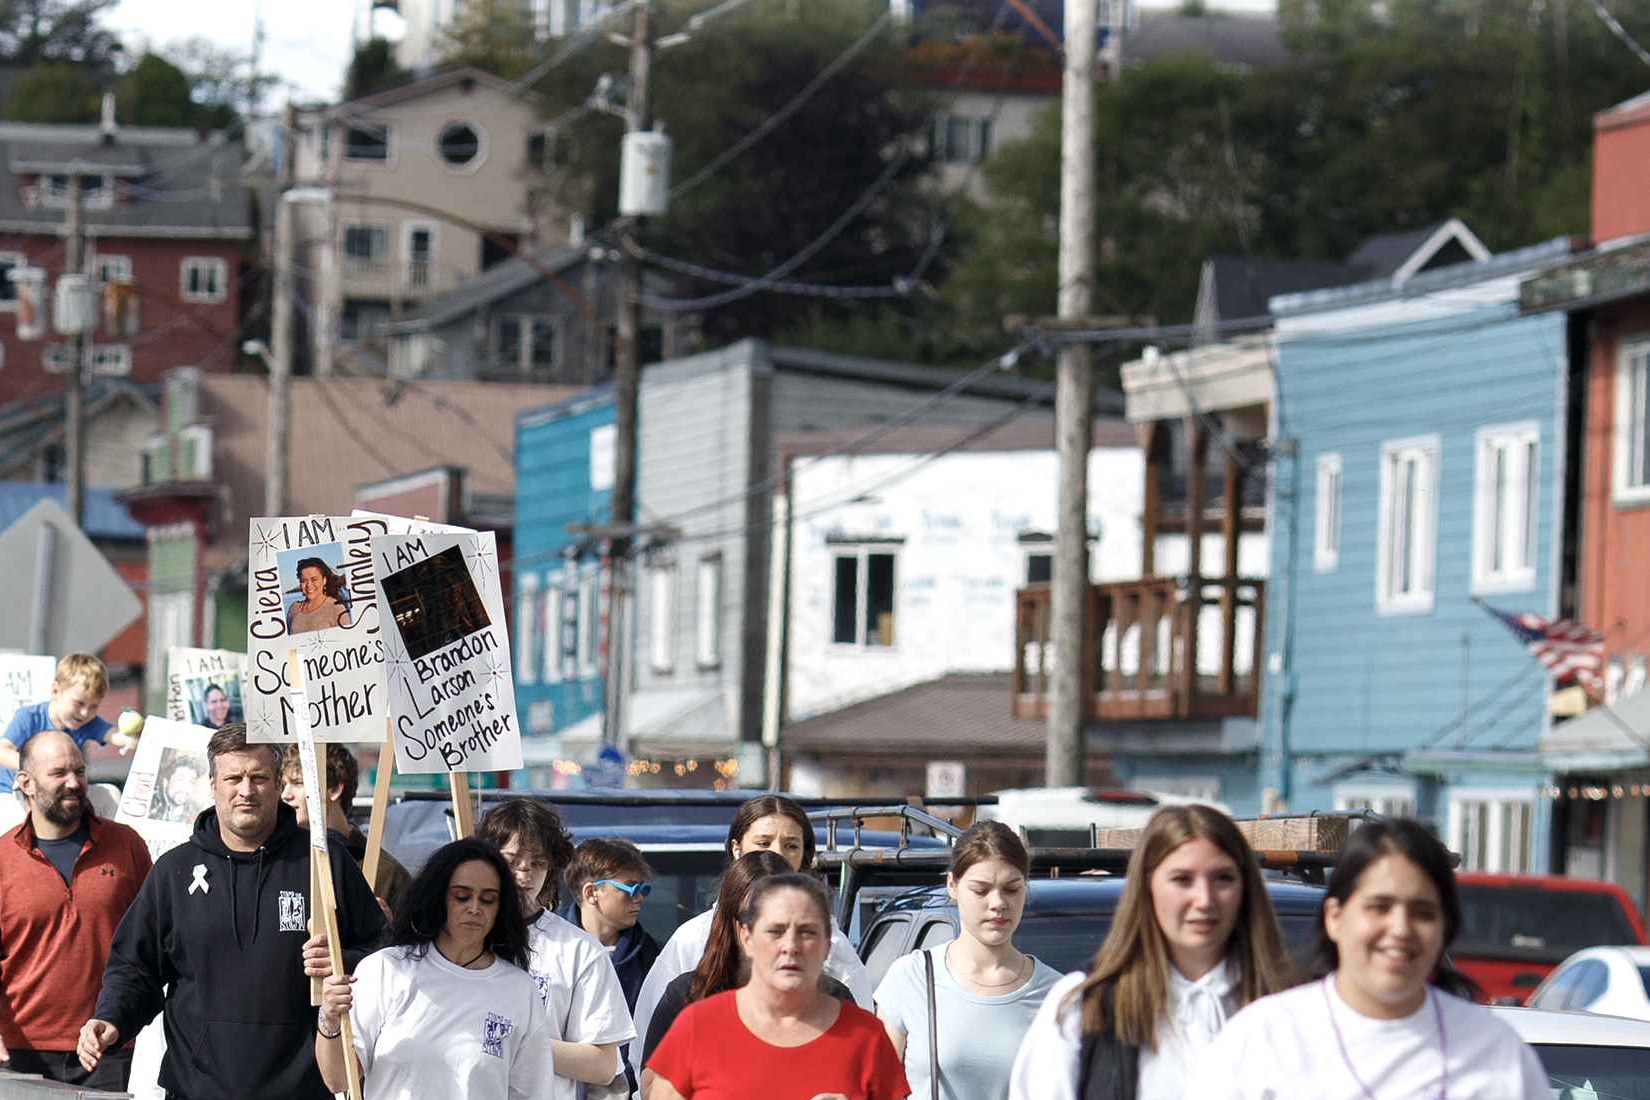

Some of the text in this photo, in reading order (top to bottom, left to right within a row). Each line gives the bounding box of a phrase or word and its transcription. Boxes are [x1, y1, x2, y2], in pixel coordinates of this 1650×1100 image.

[281, 517, 336, 549] I AM
[382, 538, 430, 573] I AM
[334, 519, 388, 634] Stanley
[250, 566, 287, 639] Ciera
[3, 669, 33, 696] AM
[199, 655, 225, 672] AM
[413, 630, 499, 685] Brandon
[403, 669, 476, 720] Larson
[397, 693, 495, 761] Someone's
[438, 714, 511, 771] Brother
[121, 772, 155, 818] Chad
